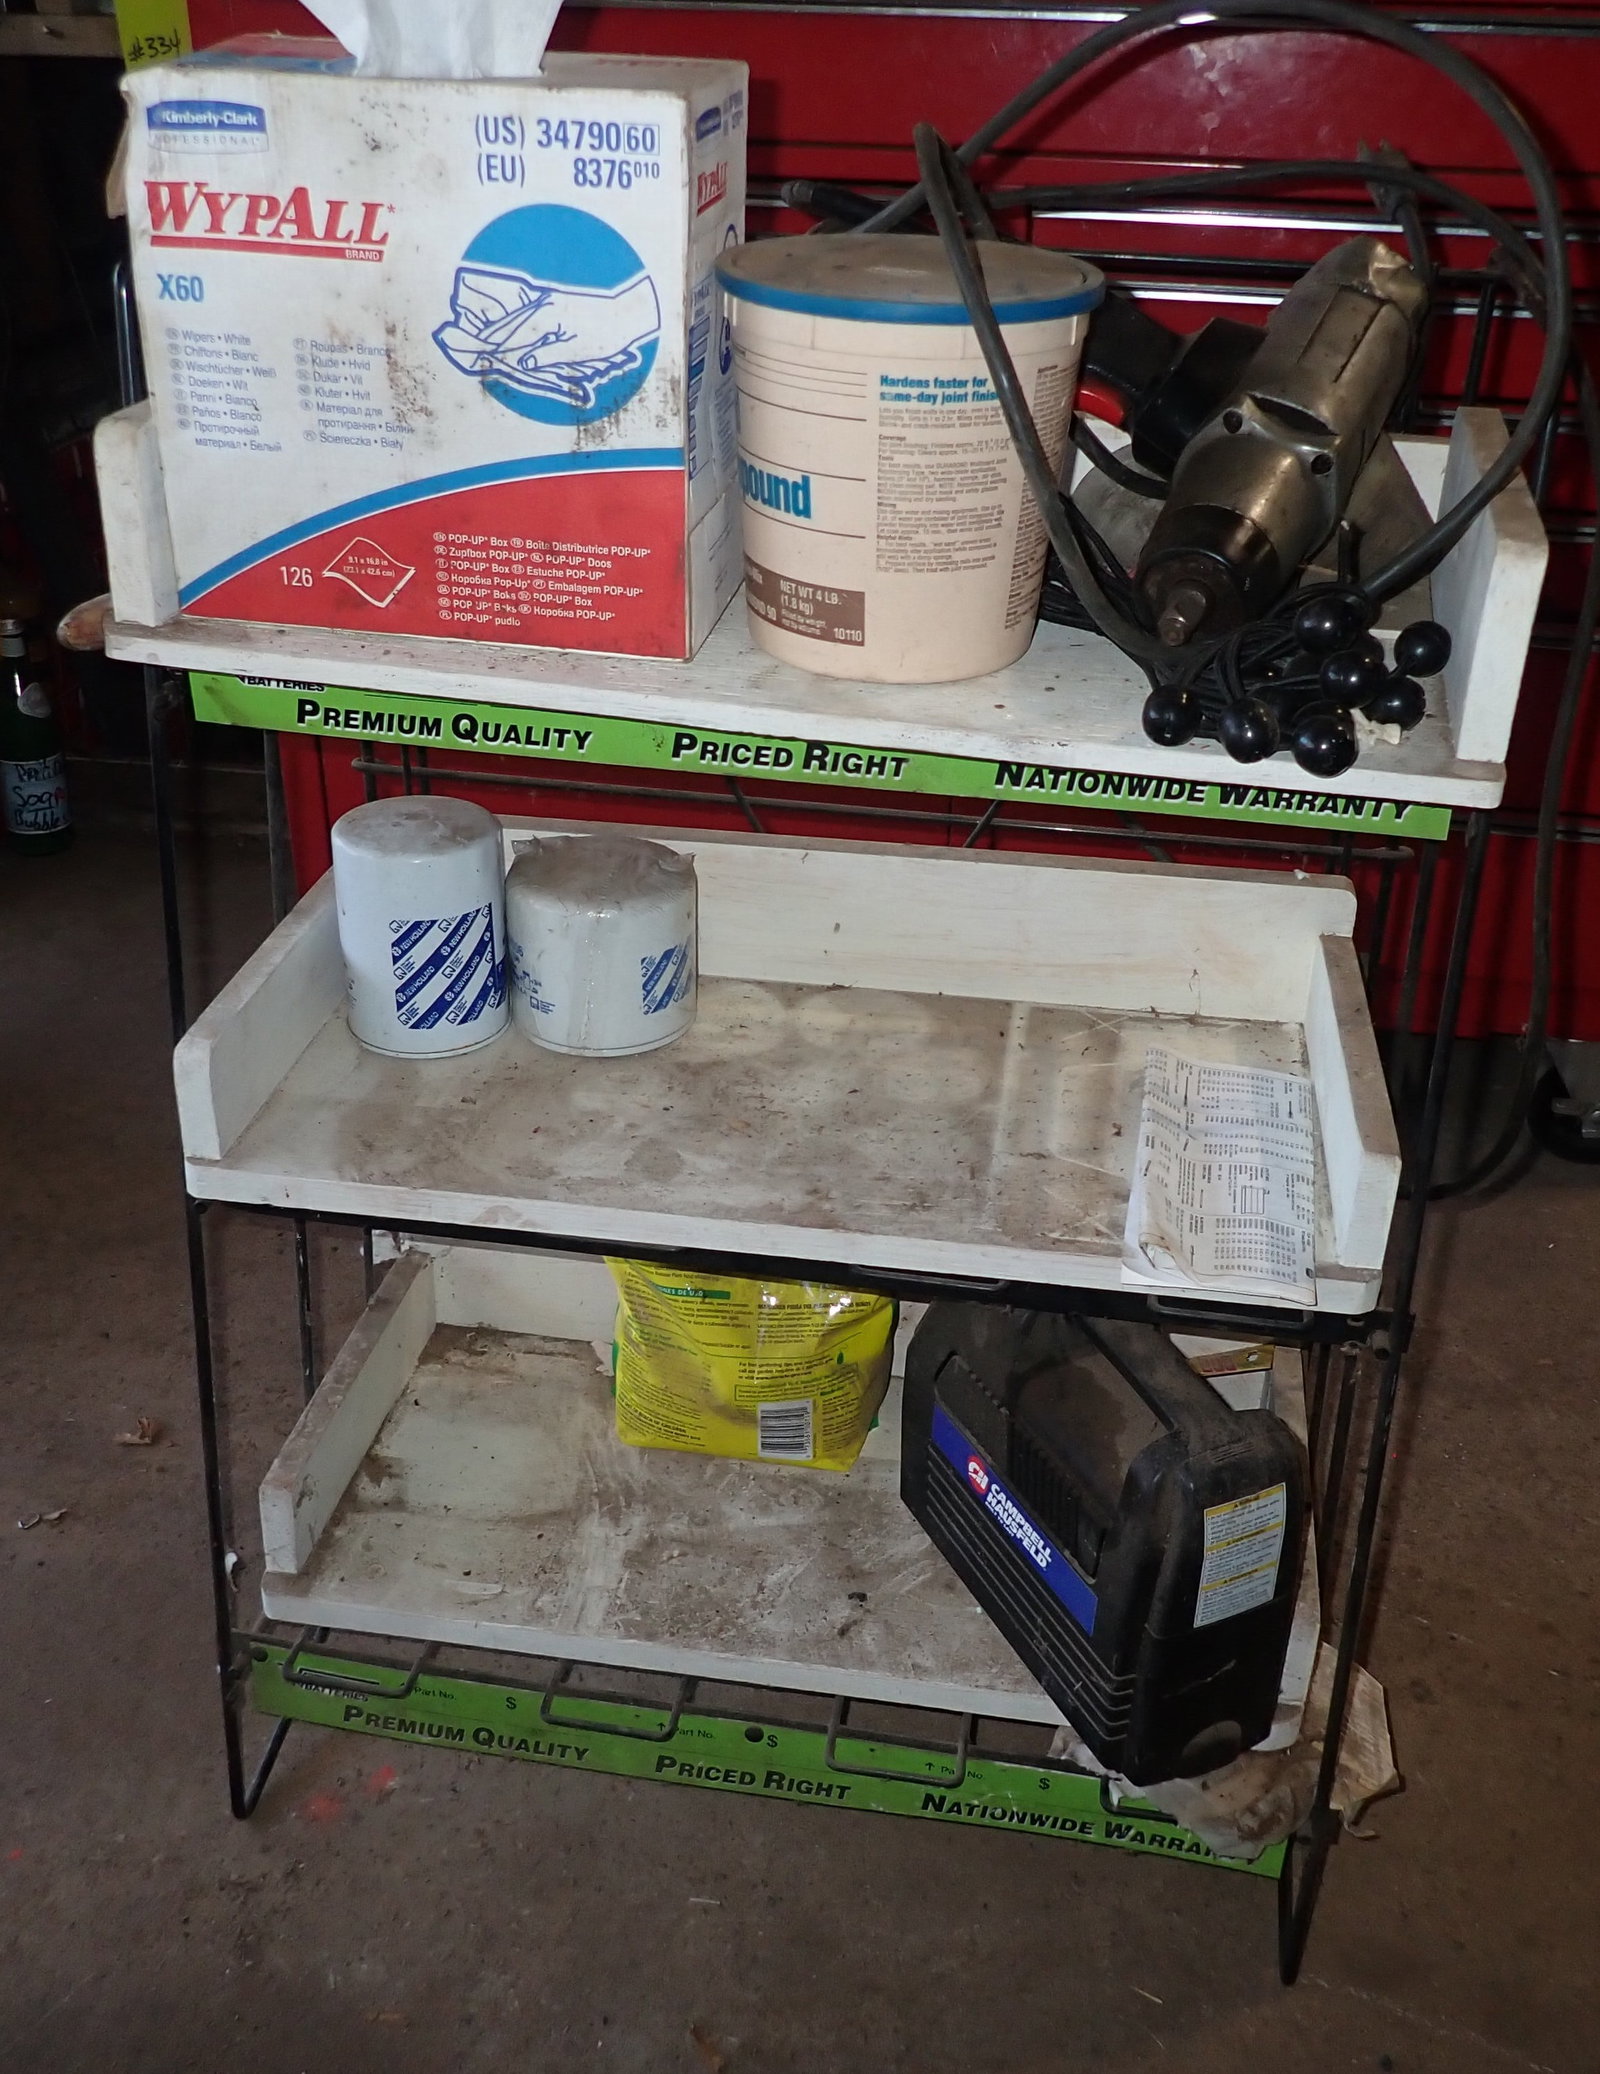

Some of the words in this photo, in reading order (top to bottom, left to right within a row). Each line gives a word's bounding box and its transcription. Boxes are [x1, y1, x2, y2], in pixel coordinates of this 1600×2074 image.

[129, 29, 180, 63] #334
[161, 110, 257, 128] Kimberly-Clark
[475, 114, 525, 148] (US)
[477, 154, 525, 188] (EU)
[346, 250, 380, 261] BRAND
[158, 272, 204, 302] X60
[181, 329, 215, 343] Wipers
[224, 333, 251, 345] White
[880, 375, 930, 388] Hardens
[933, 377, 969, 388] faster
[972, 377, 988, 388] for
[941, 391, 968, 405] joint
[972, 390, 1000, 402] finis
[491, 537, 508, 547] Box
[492, 564, 510, 573] Box
[527, 565, 564, 578] Estuche
[588, 558, 612, 569] Doos
[280, 567, 313, 588] 126
[548, 581, 602, 595] Embalagem
[575, 597, 593, 607] Box
[780, 580, 796, 594] NET
[798, 586, 814, 599] WT
[815, 590, 822, 601] 4
[825, 592, 842, 605] LB.
[494, 603, 516, 613] Bks
[781, 595, 797, 609] (1.8
[799, 598, 814, 616] kg)
[833, 627, 862, 641] 10110
[247, 677, 325, 692] BATTERIES
[296, 698, 443, 738] PREMIUM
[451, 713, 593, 751] QUALITY
[670, 732, 794, 770] PRICED
[800, 747, 910, 781] RIGHT
[994, 760, 1207, 806] NATIONWIDE
[1218, 785, 1417, 823] WARRANTY
[449, 934, 461, 948] NEW
[457, 910, 476, 936] HOLLAND
[414, 965, 435, 988] HOLLAND
[461, 955, 480, 982] HOLLAND
[986, 1492, 1047, 1568] HAUSFELD
[991, 1483, 1052, 1562] CAMPBELL
[505, 1697, 517, 1710] $
[342, 1704, 465, 1743] PREMIUM
[471, 1725, 590, 1761] QUALITY
[678, 1727, 693, 1737] art
[767, 1734, 778, 1748] $
[654, 1753, 757, 1788] PRICED
[763, 1770, 851, 1802] RIGHT
[1038, 1778, 1050, 1790] $
[920, 1792, 1094, 1837] NATIONWIDE
